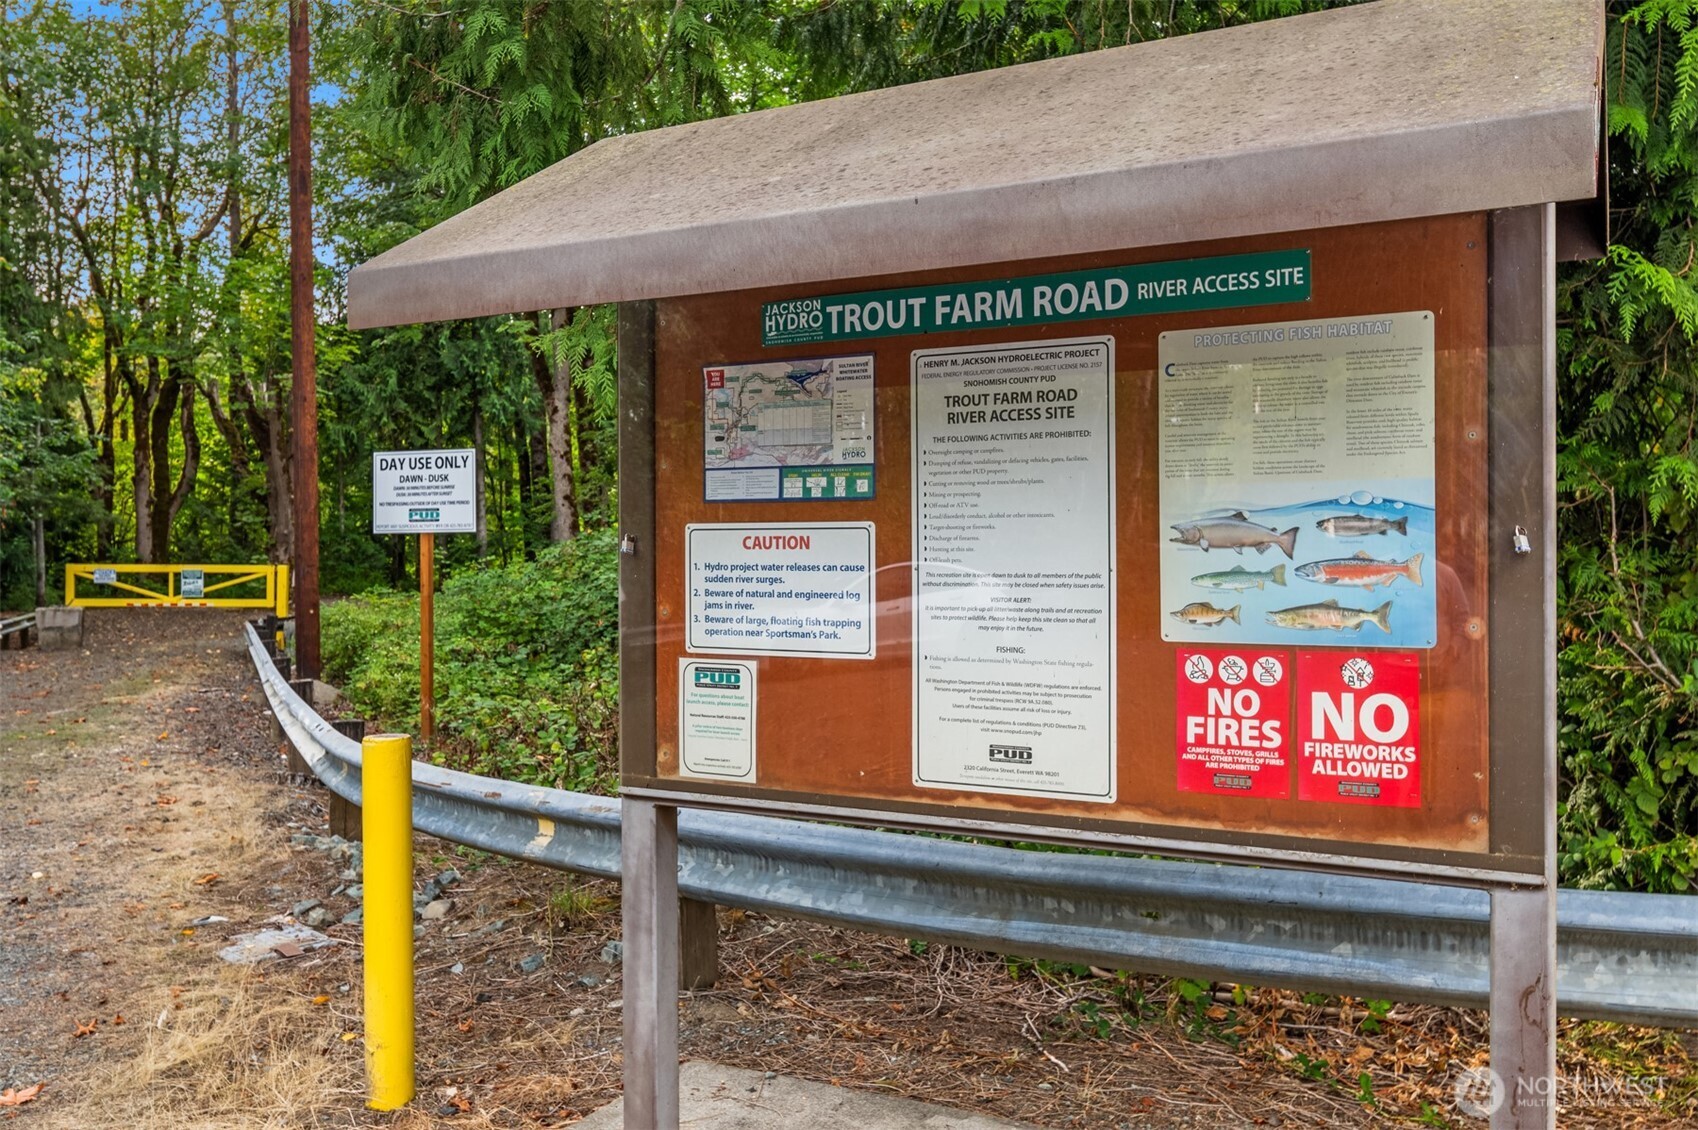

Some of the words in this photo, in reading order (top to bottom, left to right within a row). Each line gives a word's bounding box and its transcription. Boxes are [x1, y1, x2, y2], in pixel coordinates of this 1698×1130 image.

[1138, 279, 1187, 299] RIVER
[1193, 272, 1259, 294] ACCESS
[1266, 267, 1304, 287] SITE
[766, 299, 821, 316] JACKSON
[827, 297, 926, 334] TROUT
[936, 288, 1022, 325] FARM
[1034, 278, 1128, 316] ROAD
[766, 310, 823, 332] HYDRO
[1194, 329, 1284, 348] PROTECTING
[1288, 326, 1322, 341] FISH
[1327, 320, 1392, 338] HABITAT
[924, 360, 948, 368] HENRY
[961, 356, 996, 366] JACKSON
[998, 352, 1062, 362] HYDROELECTRIC
[1065, 349, 1100, 358] PROJECT
[964, 378, 1007, 387] SNOHOMISH
[1009, 376, 1039, 384] COUNTY
[944, 394, 990, 408] TROUT
[994, 391, 1032, 405] FARM
[1037, 388, 1077, 403] ROAD
[948, 411, 986, 424] RIVER
[990, 408, 1041, 422] ACCESS
[1046, 406, 1075, 419] SITE
[947, 434, 988, 443] FOLLOWING
[1045, 430, 1091, 438] PROHIBITED:
[842, 450, 866, 459] HYDRO
[380, 458, 405, 471] DAY
[409, 457, 431, 470] USE
[435, 456, 469, 469] ONLY
[400, 475, 423, 483] DAWN
[428, 474, 449, 482] DUSK
[743, 536, 810, 550] CAUTION
[705, 563, 728, 572] Hydro
[731, 563, 759, 572] project
[786, 563, 820, 572] releases
[756, 577, 785, 585] surges.
[705, 589, 733, 597] Beware
[777, 590, 792, 598] and
[795, 591, 844, 600] engineered
[846, 591, 860, 601] log
[704, 602, 723, 611] jams
[735, 602, 754, 610] river.
[705, 615, 733, 624] Beware
[746, 616, 768, 626] large,
[771, 617, 803, 627] floating
[806, 618, 821, 626] fish
[823, 619, 861, 629] trapping
[705, 629, 743, 637] operation
[766, 629, 816, 639] Sportsman's
[819, 630, 841, 639] Park.
[694, 672, 740, 684] PUD
[1208, 688, 1260, 717] NO
[1312, 692, 1409, 743] NO
[1187, 716, 1281, 748] FIRES
[989, 748, 1032, 760] PUD
[1187, 746, 1225, 755] CAMPFIRES,
[1227, 749, 1254, 757] STOVES,
[1304, 742, 1416, 762] FIREWORKS
[1220, 763, 1259, 771] PROHIBITED
[1312, 760, 1408, 779] ALLOWED
[1214, 776, 1252, 786] PUD
[1338, 784, 1380, 795] PUD
